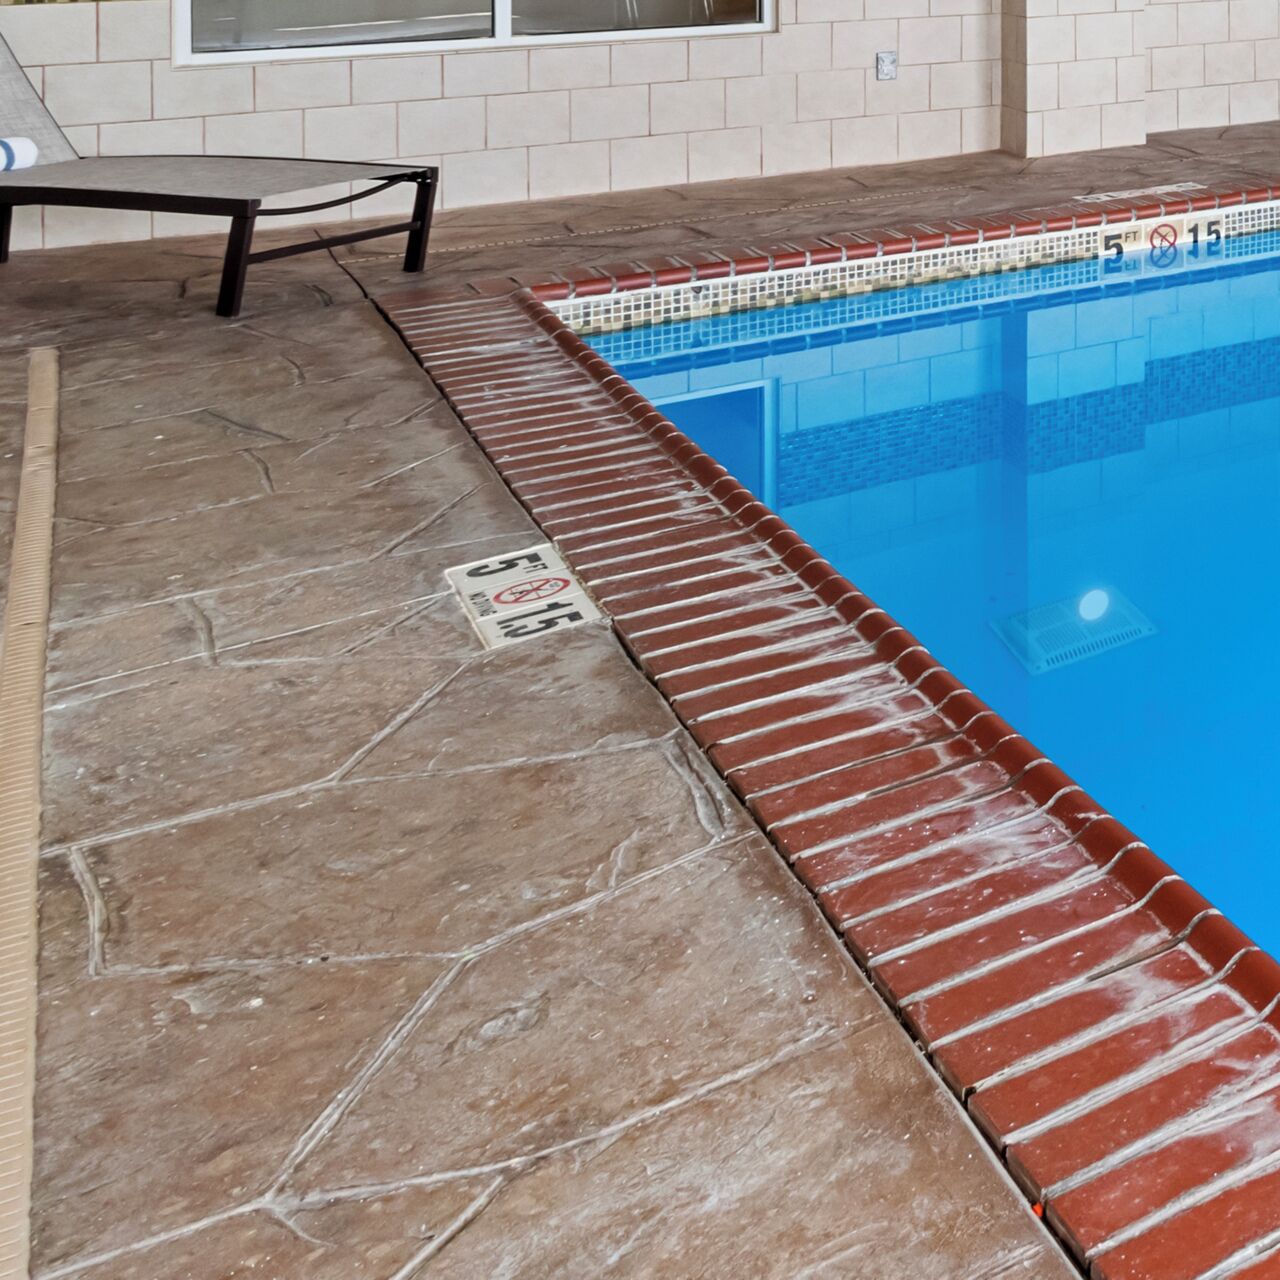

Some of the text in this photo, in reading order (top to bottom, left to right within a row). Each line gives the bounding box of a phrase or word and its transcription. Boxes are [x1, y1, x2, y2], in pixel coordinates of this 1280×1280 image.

[1104, 234, 1123, 255] 5
[1125, 231, 1138, 242] FT
[466, 552, 543, 579] 5
